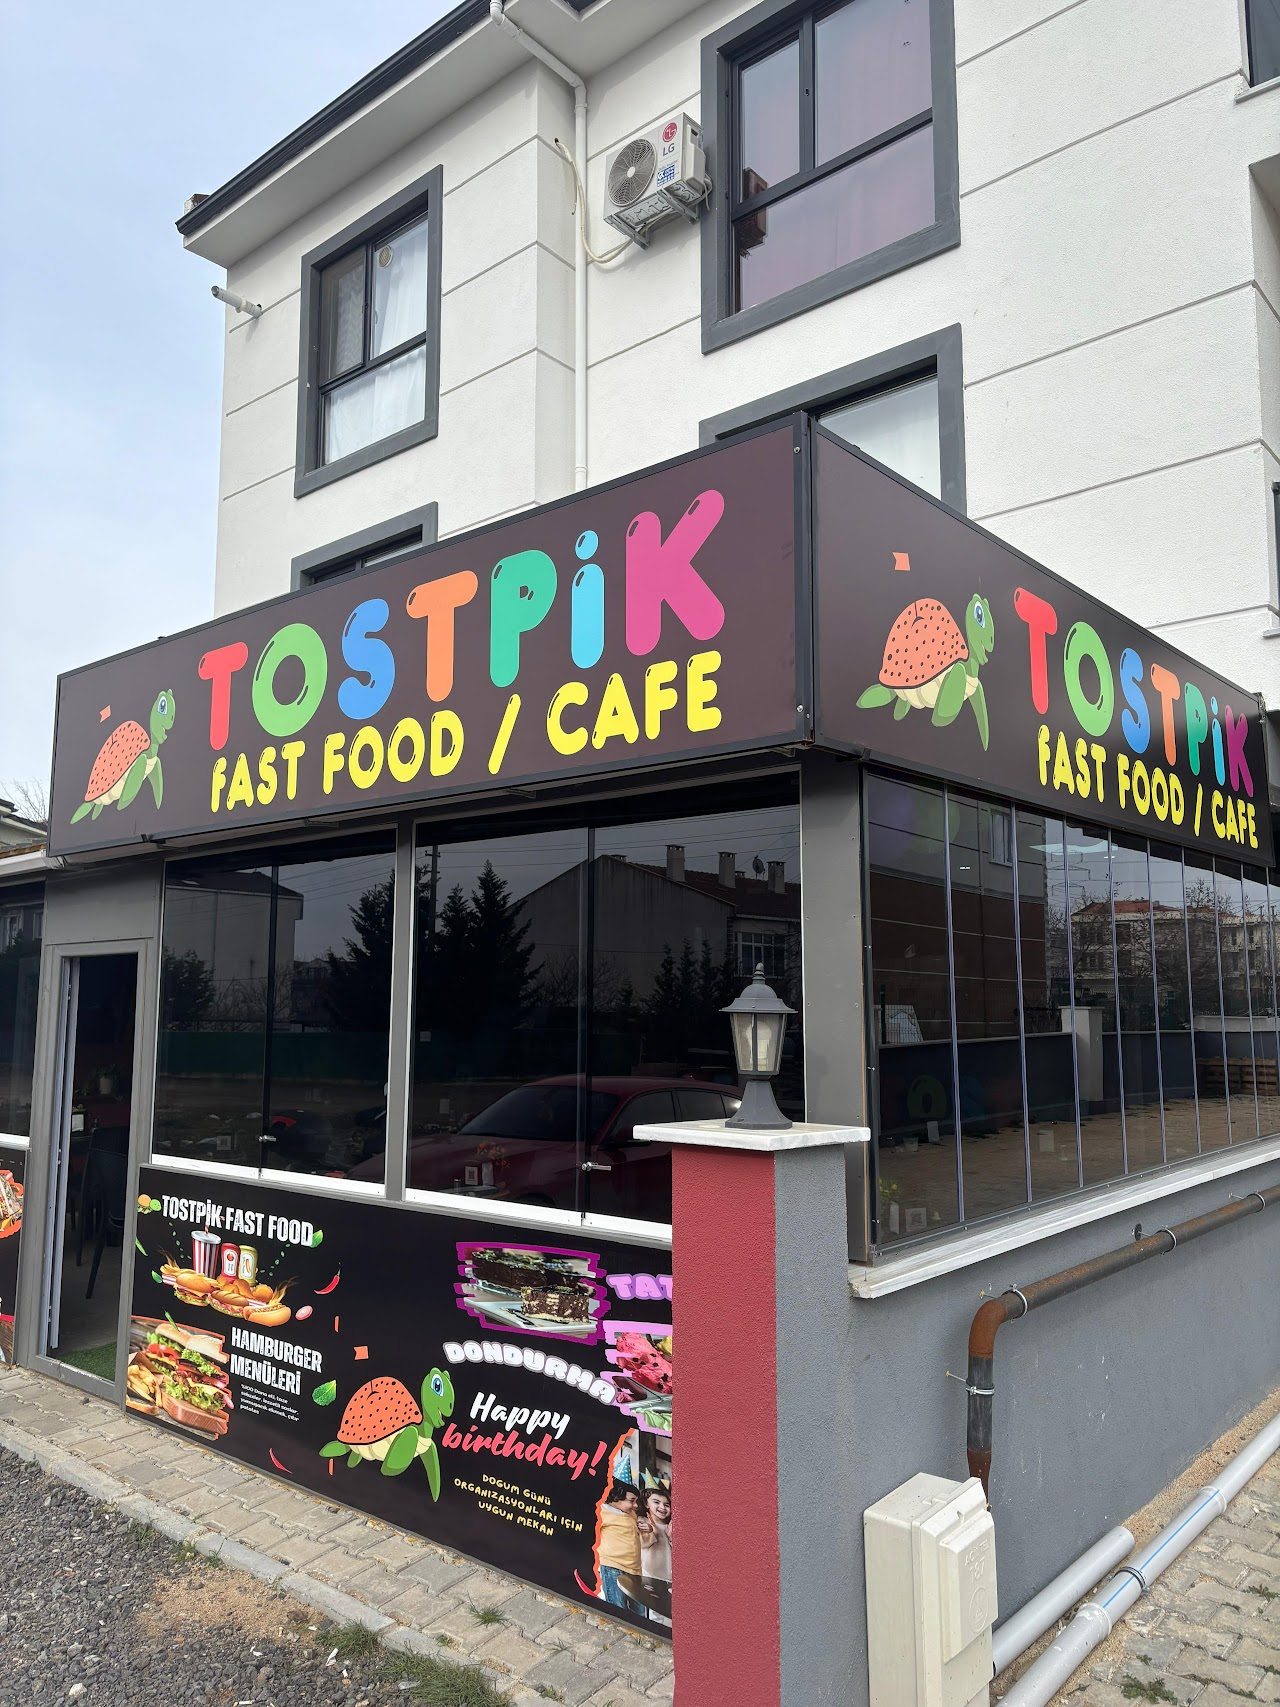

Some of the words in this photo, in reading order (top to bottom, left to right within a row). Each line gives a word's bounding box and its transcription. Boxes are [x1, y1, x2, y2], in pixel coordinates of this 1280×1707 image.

[663, 143, 675, 156] LG
[211, 741, 304, 812] FAST
[323, 710, 464, 795] FOOD
[488, 694, 521, 774] /
[547, 651, 722, 756] CAFE
[1038, 725, 1106, 802] FAST
[1117, 753, 1185, 826] FOOD
[1194, 783, 1203, 837] /
[1212, 790, 1259, 849] CAFE
[226, 1207, 264, 1236] FAST
[268, 1215, 313, 1247] FOOD
[232, 1327, 322, 1373] HAMBURGER
[443, 1340, 617, 1405] DONDURMA
[230, 1354, 301, 1395] MENÜLERİ
[470, 1392, 570, 1440] Happy
[442, 1423, 608, 1481] birthday!
[478, 1501, 514, 1521] UYGUN
[517, 1516, 554, 1536] MEKAN
